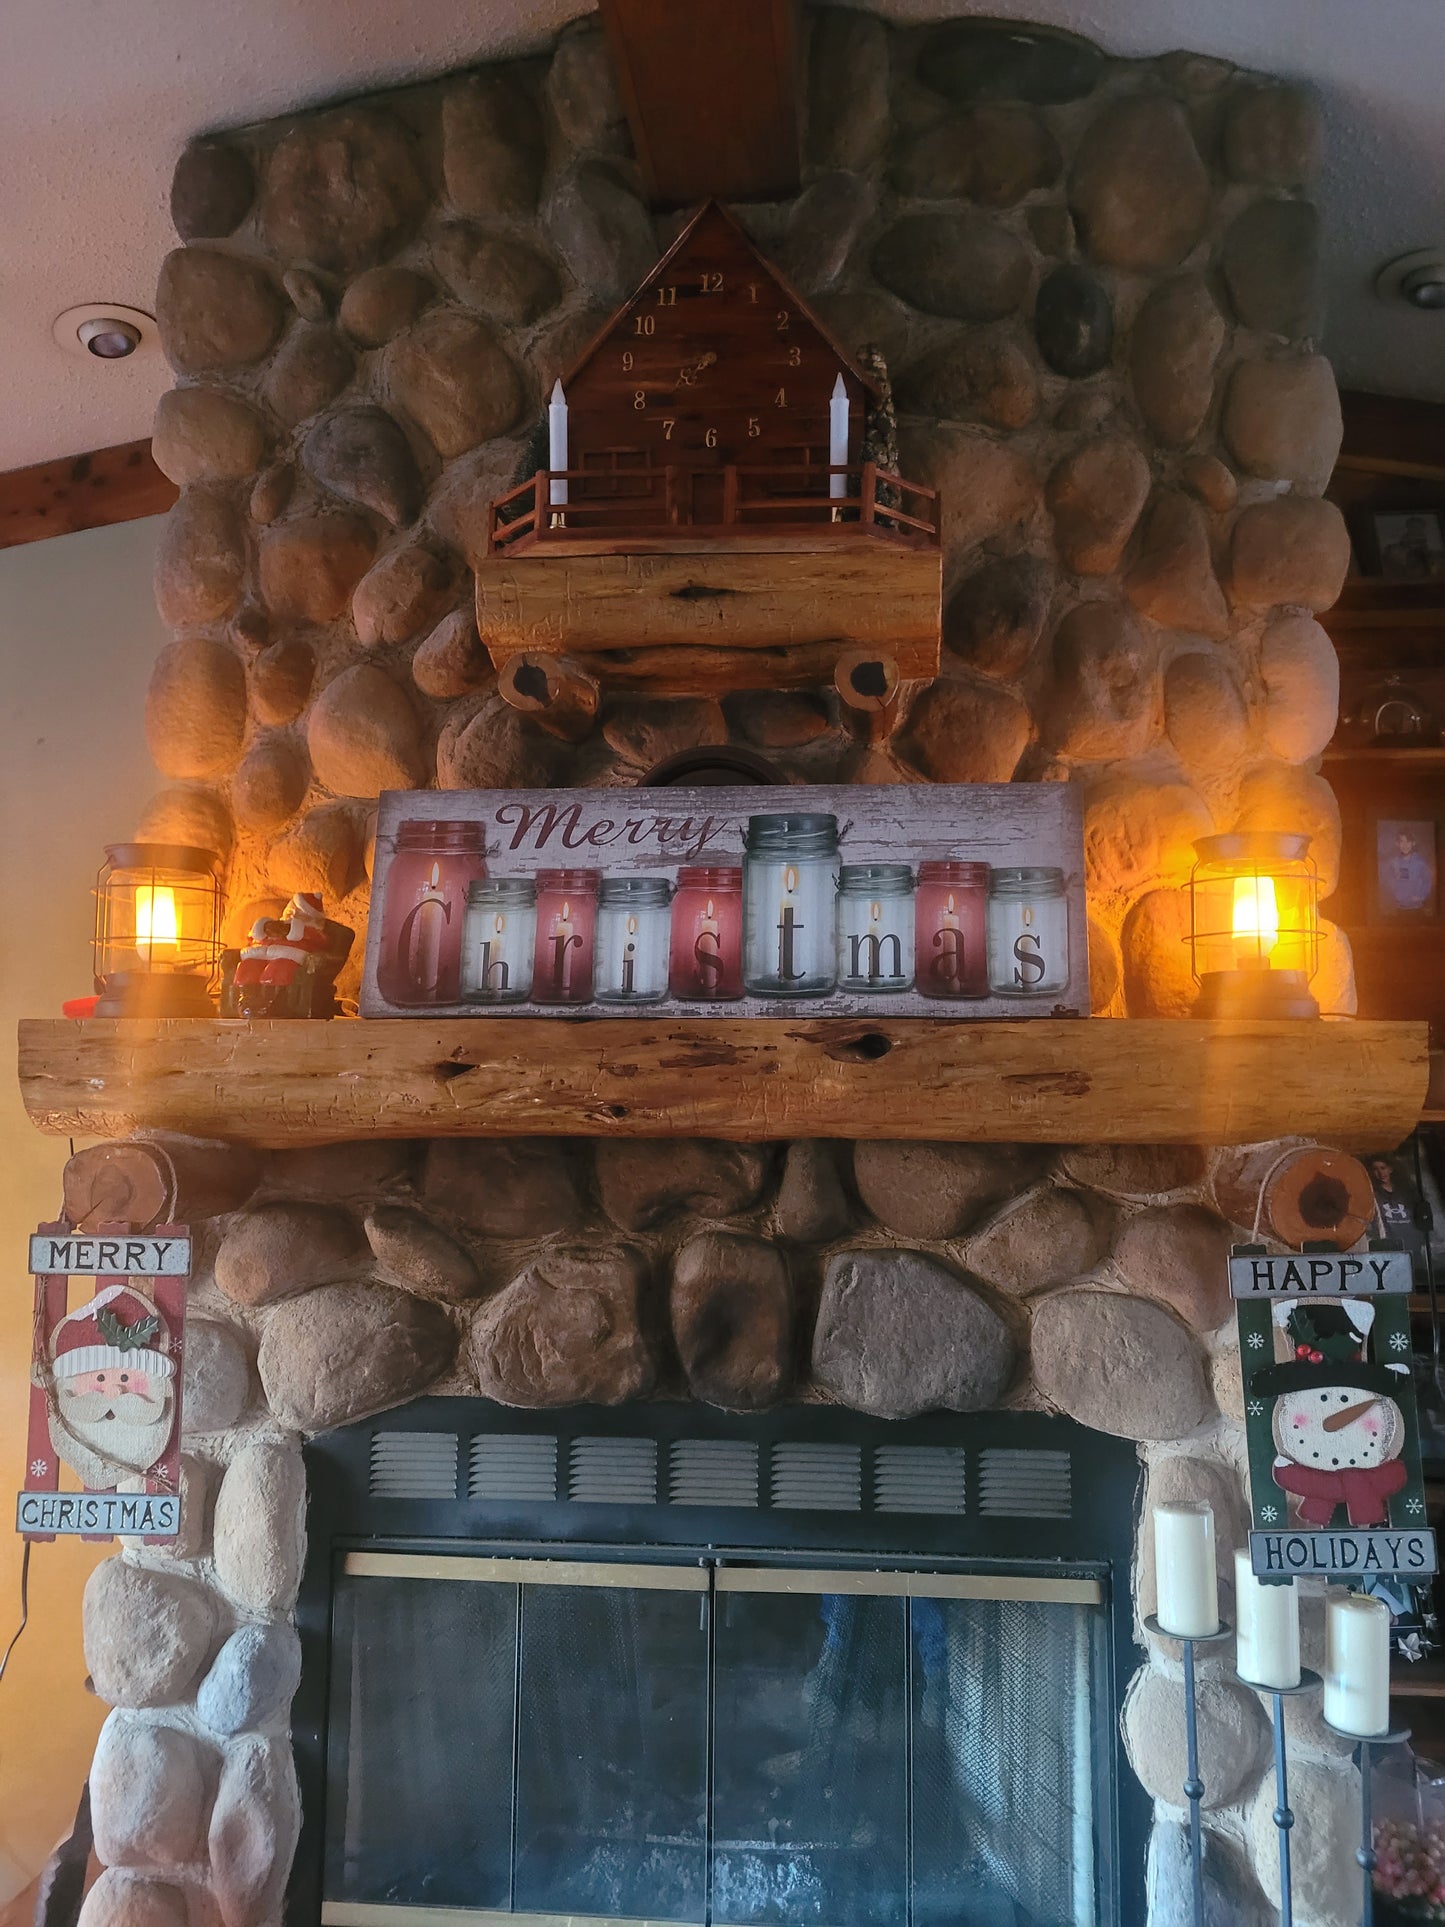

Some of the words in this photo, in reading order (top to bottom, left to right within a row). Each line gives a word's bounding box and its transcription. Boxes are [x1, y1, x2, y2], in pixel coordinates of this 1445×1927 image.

[700, 273, 724, 292] 12
[657, 287, 677, 306] 11
[749, 286, 759, 303] 1
[634, 316, 655, 335] 10
[777, 311, 789, 330] 2
[623, 352, 633, 371] 9
[790, 348, 800, 366] 3
[634, 390, 646, 410] 8
[775, 388, 787, 408] 4
[663, 420, 675, 440] 7
[749, 418, 760, 437] 5
[705, 428, 717, 448] 6
[495, 802, 729, 859] Merry
[398, 897, 1047, 995] Christmas
[49, 1241, 172, 1270] MERRY
[1252, 1260, 1391, 1291] HAPPY
[22, 1499, 173, 1530] CHRISTMAS
[1265, 1537, 1424, 1569] HOLIDAYS
